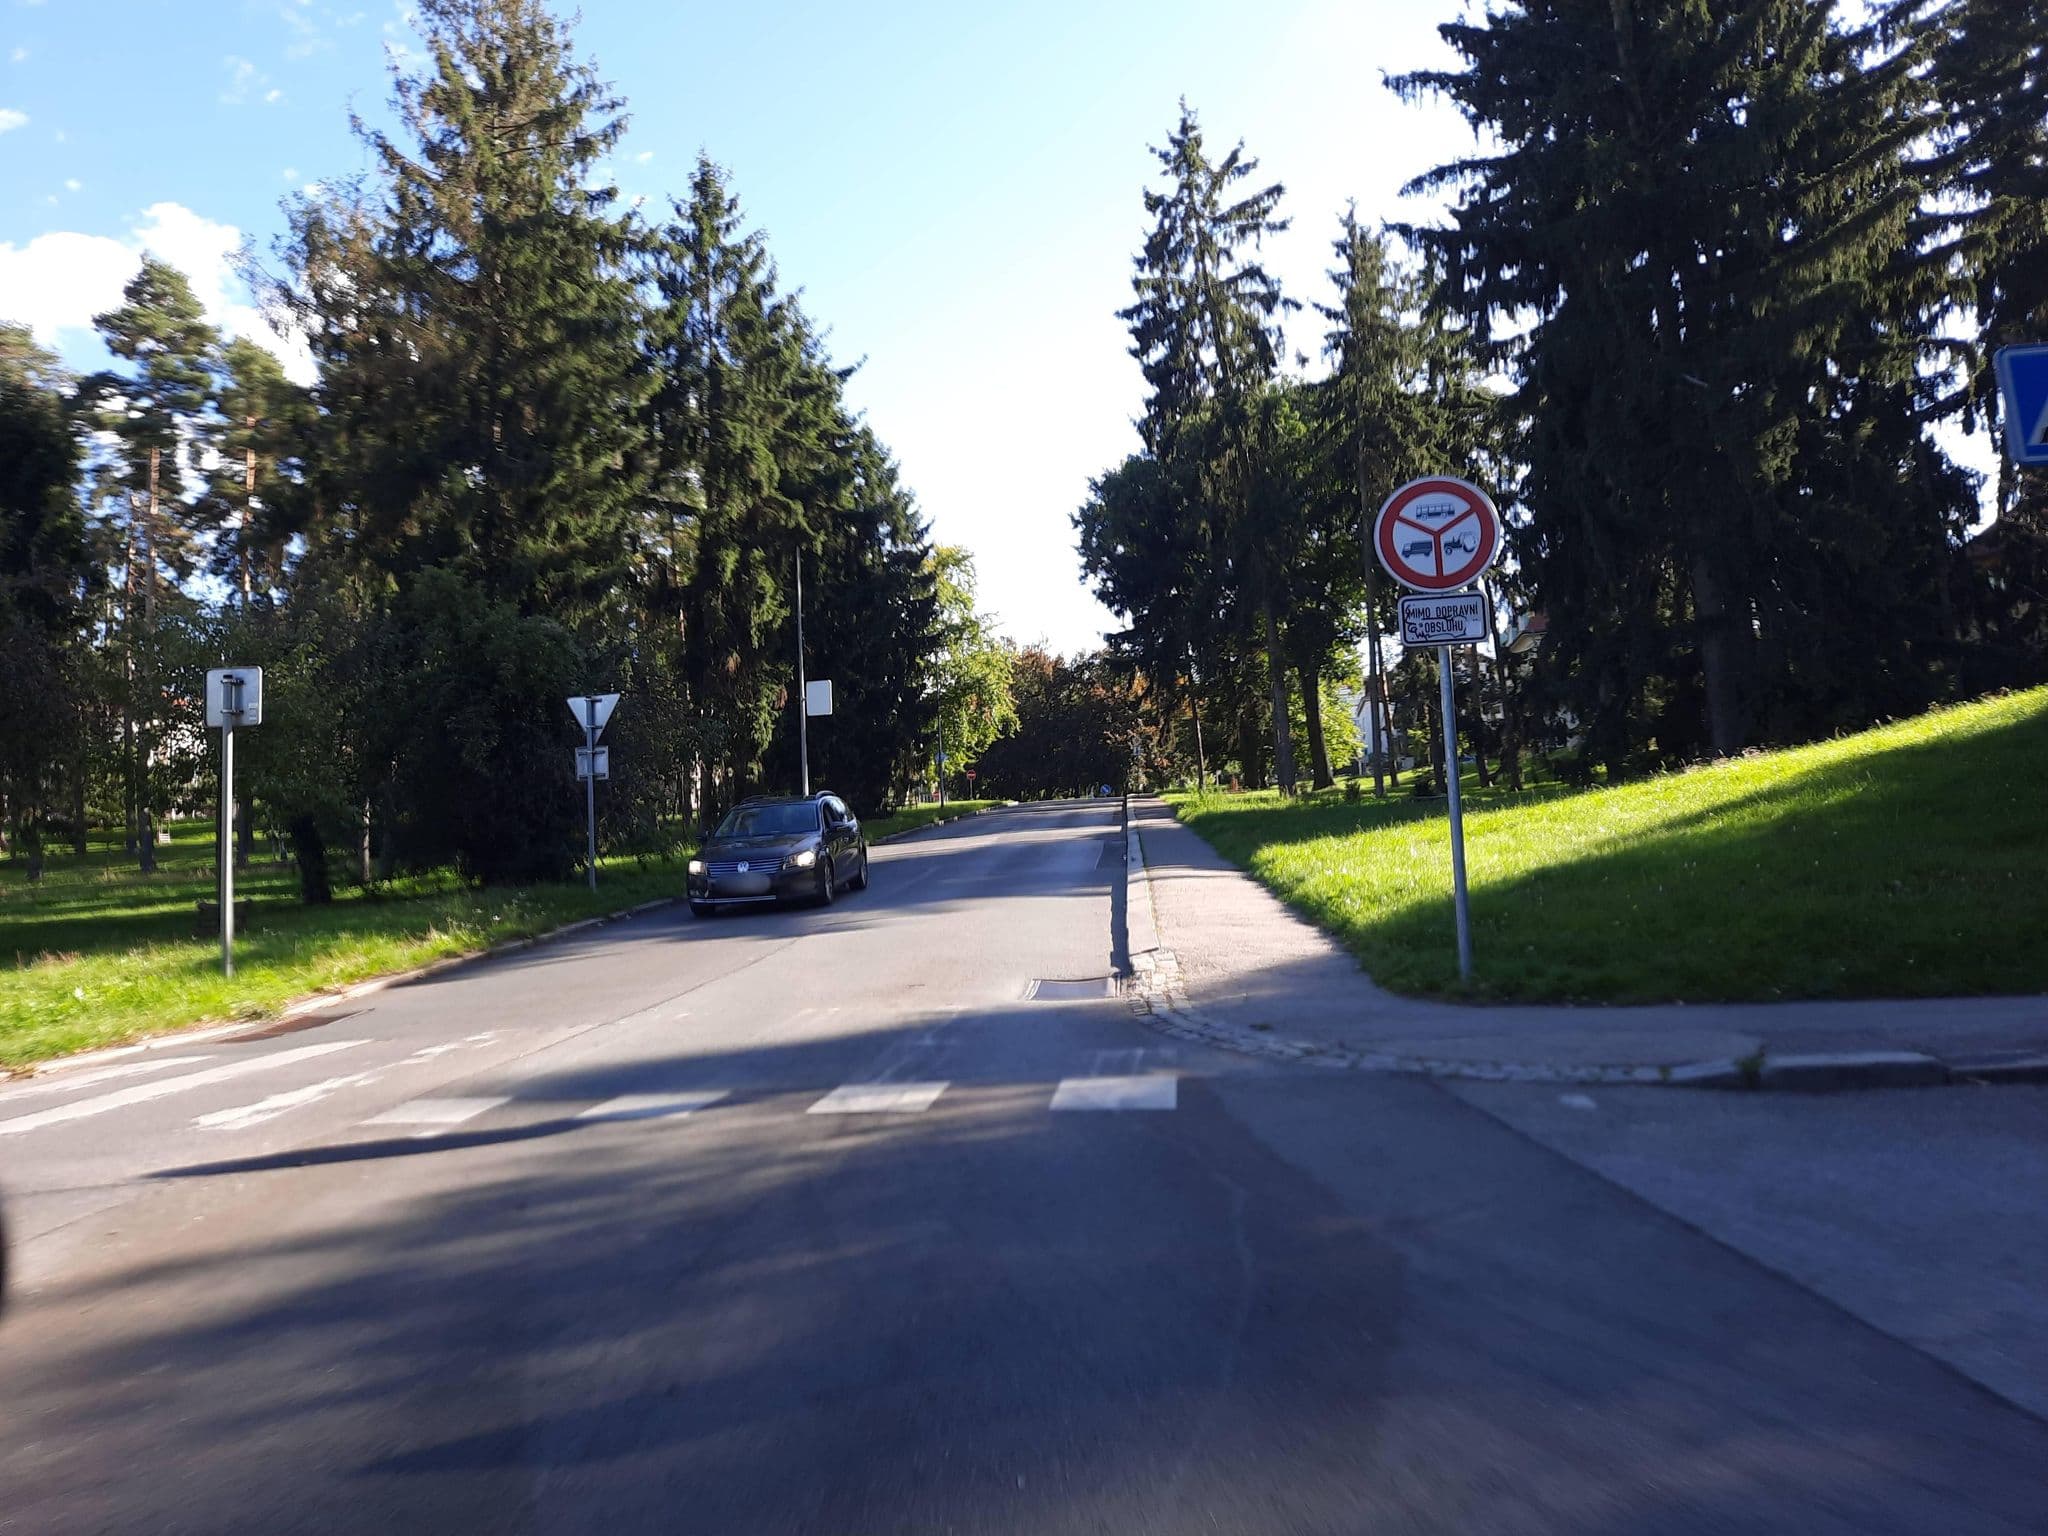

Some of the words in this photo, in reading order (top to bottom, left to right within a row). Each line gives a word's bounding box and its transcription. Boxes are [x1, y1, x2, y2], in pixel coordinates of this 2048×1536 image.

[1409, 606, 1431, 619] MIMO
[1436, 602, 1478, 618] DOPRAVNÍ
[1424, 620, 1463, 633] OBSLUHU
